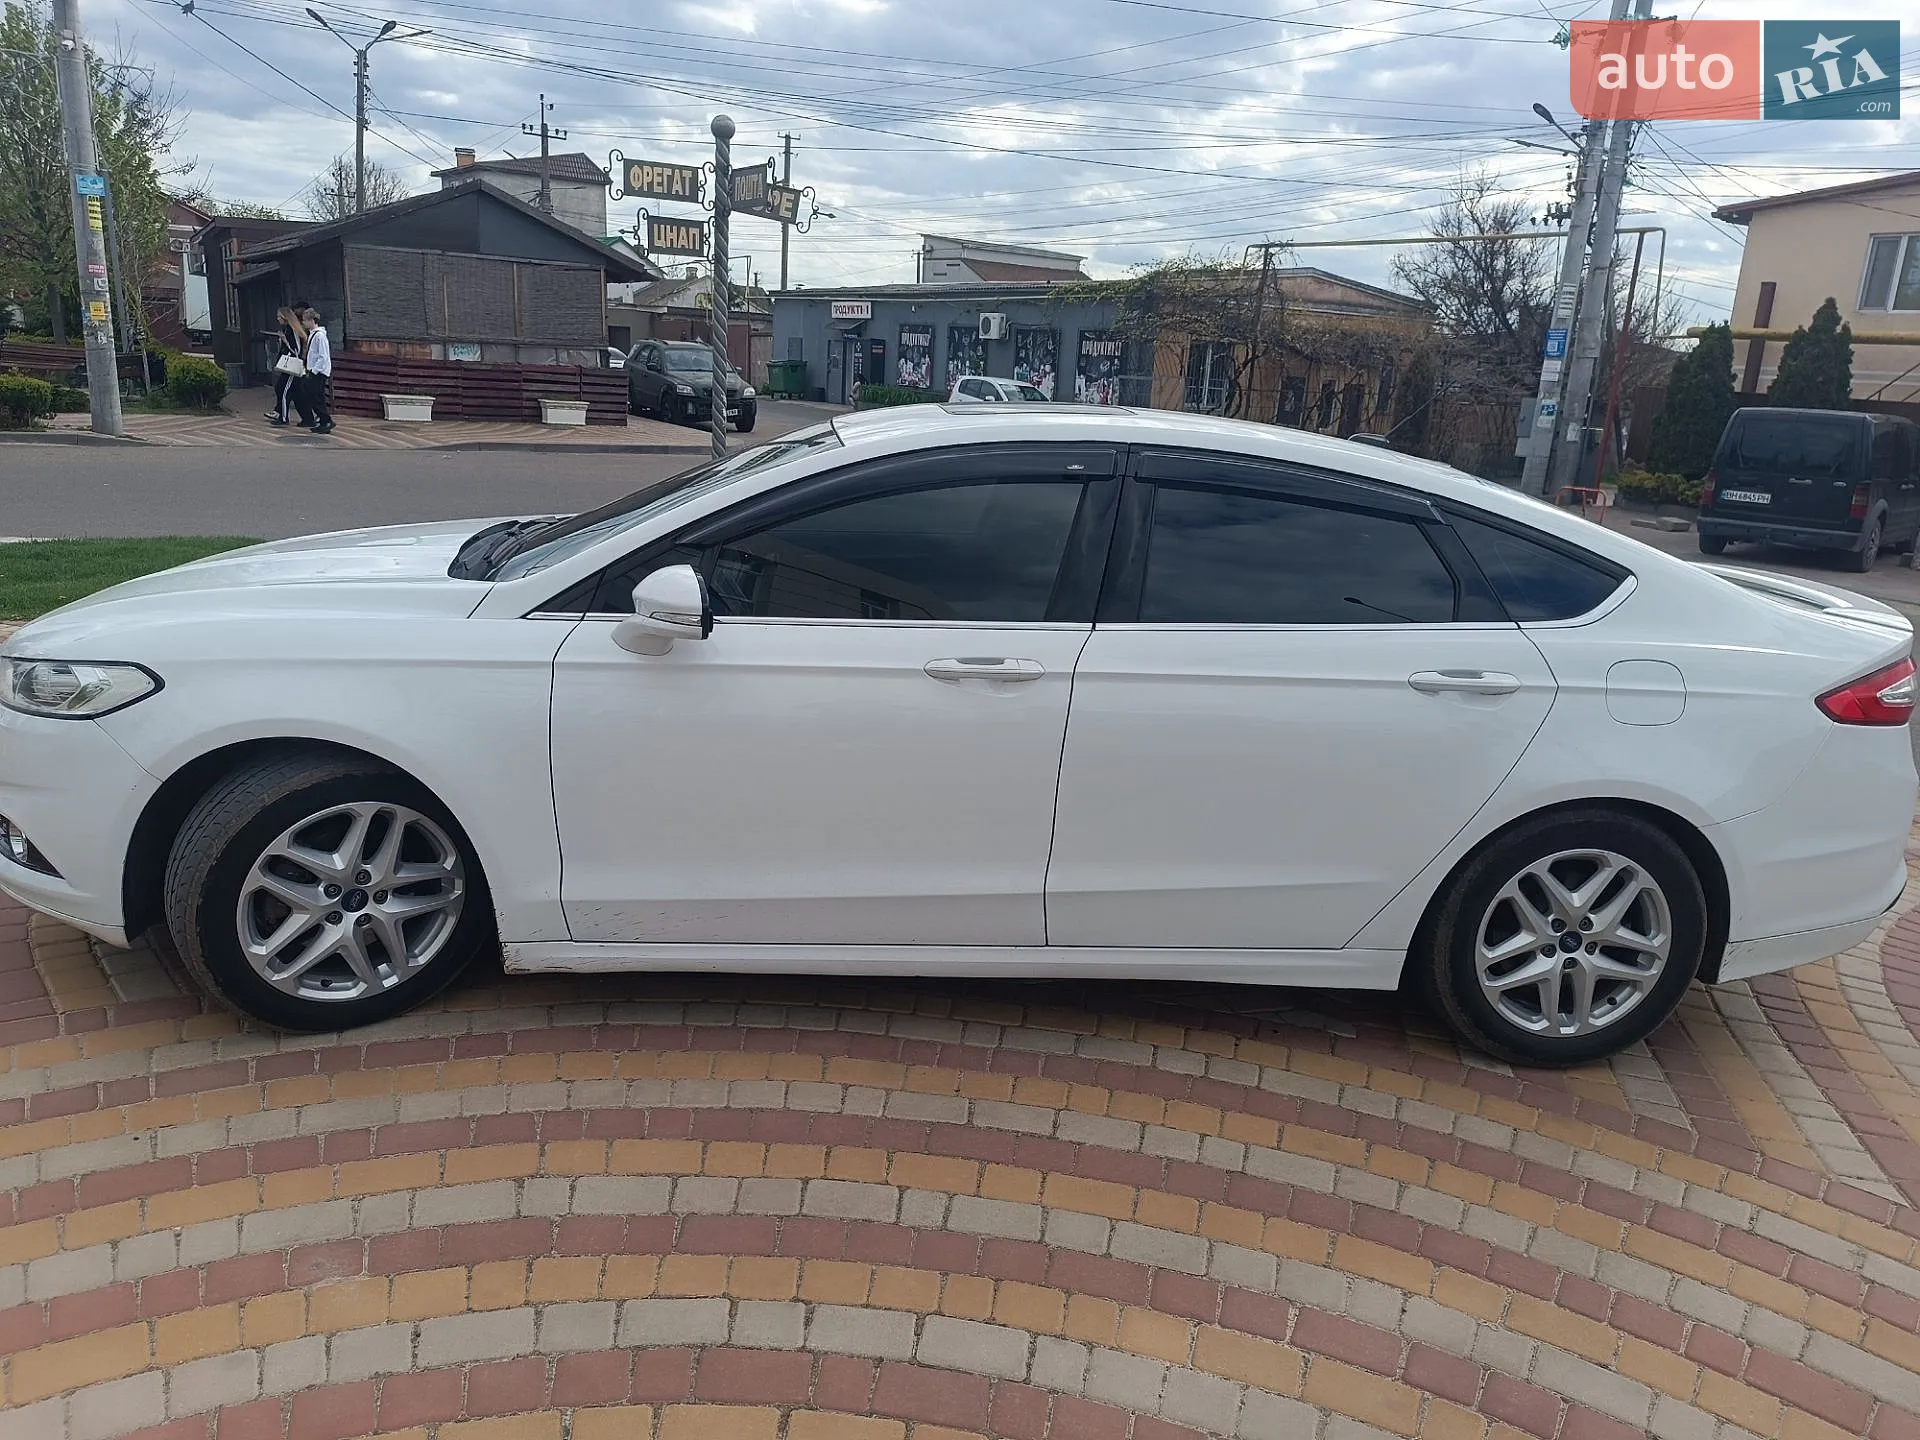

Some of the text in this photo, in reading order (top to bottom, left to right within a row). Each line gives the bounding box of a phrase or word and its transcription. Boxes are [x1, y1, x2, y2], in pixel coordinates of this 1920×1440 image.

[629, 164, 693, 196] ФРЕГАТ
[734, 173, 763, 202] ПОШТА
[752, 189, 795, 218] РЕ
[653, 223, 700, 250] ЦНАП
